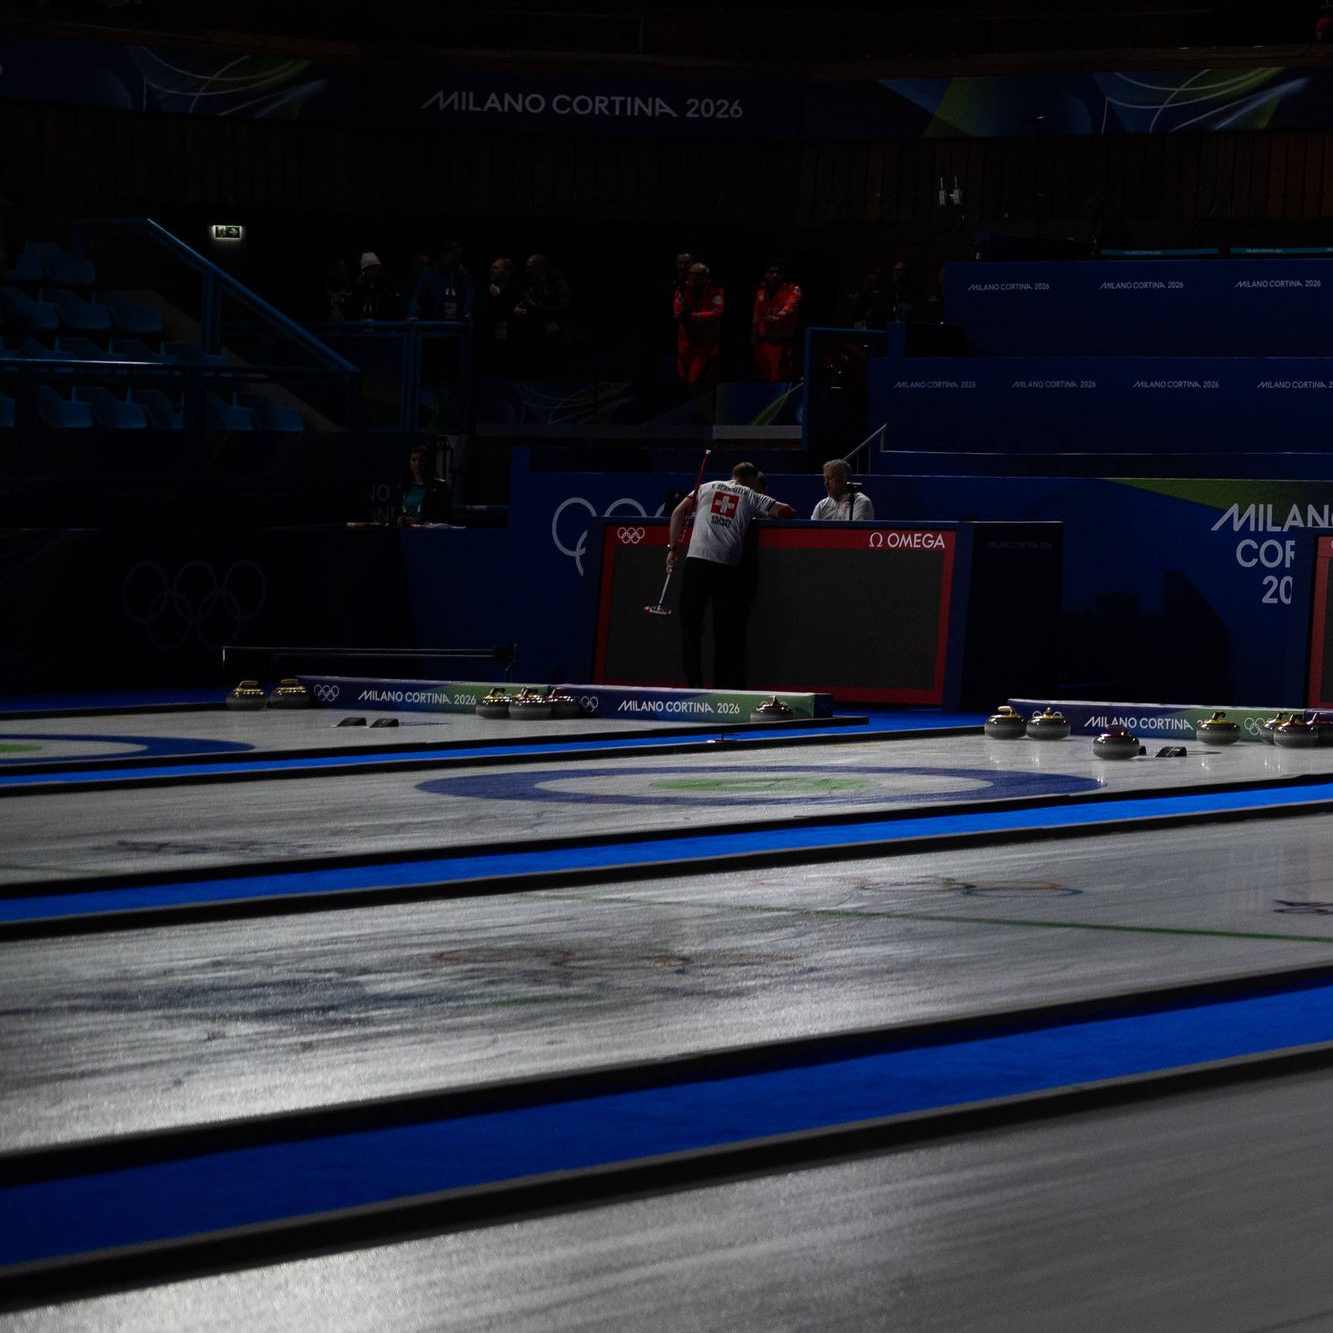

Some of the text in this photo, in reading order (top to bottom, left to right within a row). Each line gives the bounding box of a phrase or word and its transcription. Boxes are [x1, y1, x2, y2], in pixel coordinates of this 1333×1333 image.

[417, 90, 744, 119] MILANO CORTINA 2026
[1133, 281, 1167, 289] CORTINA
[1168, 281, 1184, 289] 2026
[1045, 380, 1079, 388] CORTINA
[1080, 380, 1096, 388] 2026
[887, 533, 945, 549] OMEGA
[1262, 575, 1293, 605] 20
[357, 690, 476, 705] MILANO CORTINA 2026
[617, 699, 740, 714] MILANO CORTINA 2026
[1084, 715, 1137, 728] MILANO
[1139, 716, 1194, 731] CORTINA
